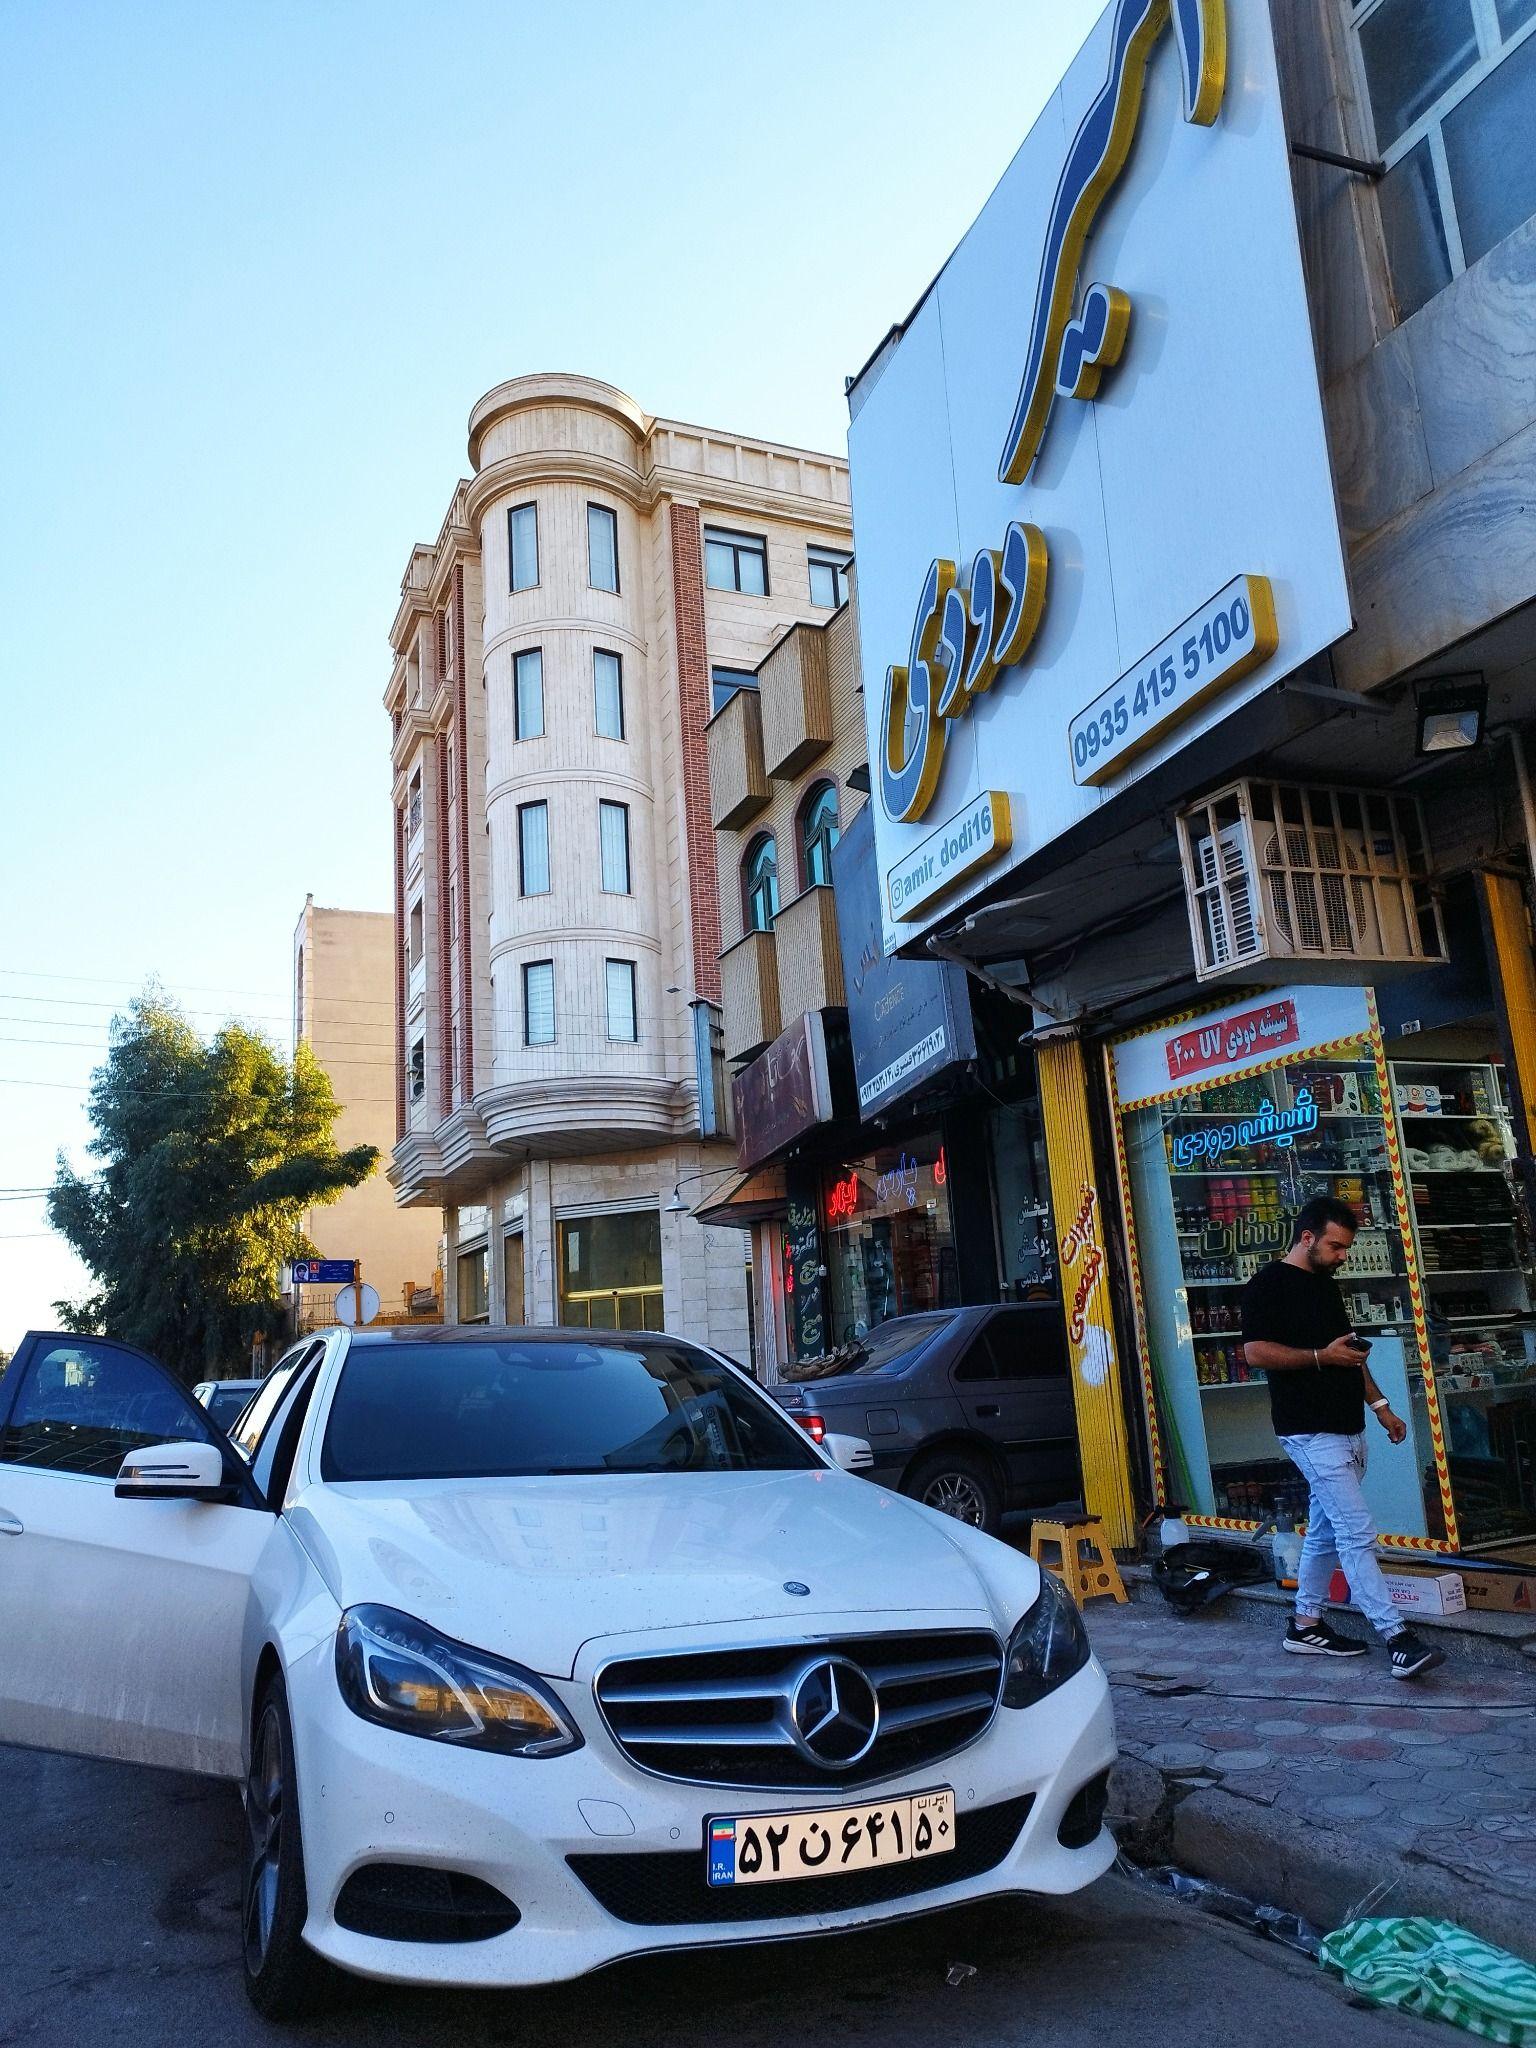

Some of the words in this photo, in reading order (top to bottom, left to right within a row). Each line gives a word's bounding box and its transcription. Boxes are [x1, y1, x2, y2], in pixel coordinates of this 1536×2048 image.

[1074, 694, 1129, 768] 0935
[1132, 655, 1177, 718] 415
[1182, 597, 1250, 680] 5100
[1198, 1026, 1222, 1059] UV
[1225, 1021, 1256, 1059] دودی
[1259, 1005, 1288, 1041] شیشه
[1238, 1088, 1319, 1147] شیشه
[1173, 1124, 1236, 1167] دودی
[1061, 1182, 1096, 1266] تعمیرات
[1069, 1243, 1102, 1345] تخصصی
[917, 1794, 948, 1810] ایران
[914, 1812, 950, 1852] ۵۰
[712, 1862, 727, 1872] I.R.
[712, 1871, 734, 1881] IRAN
